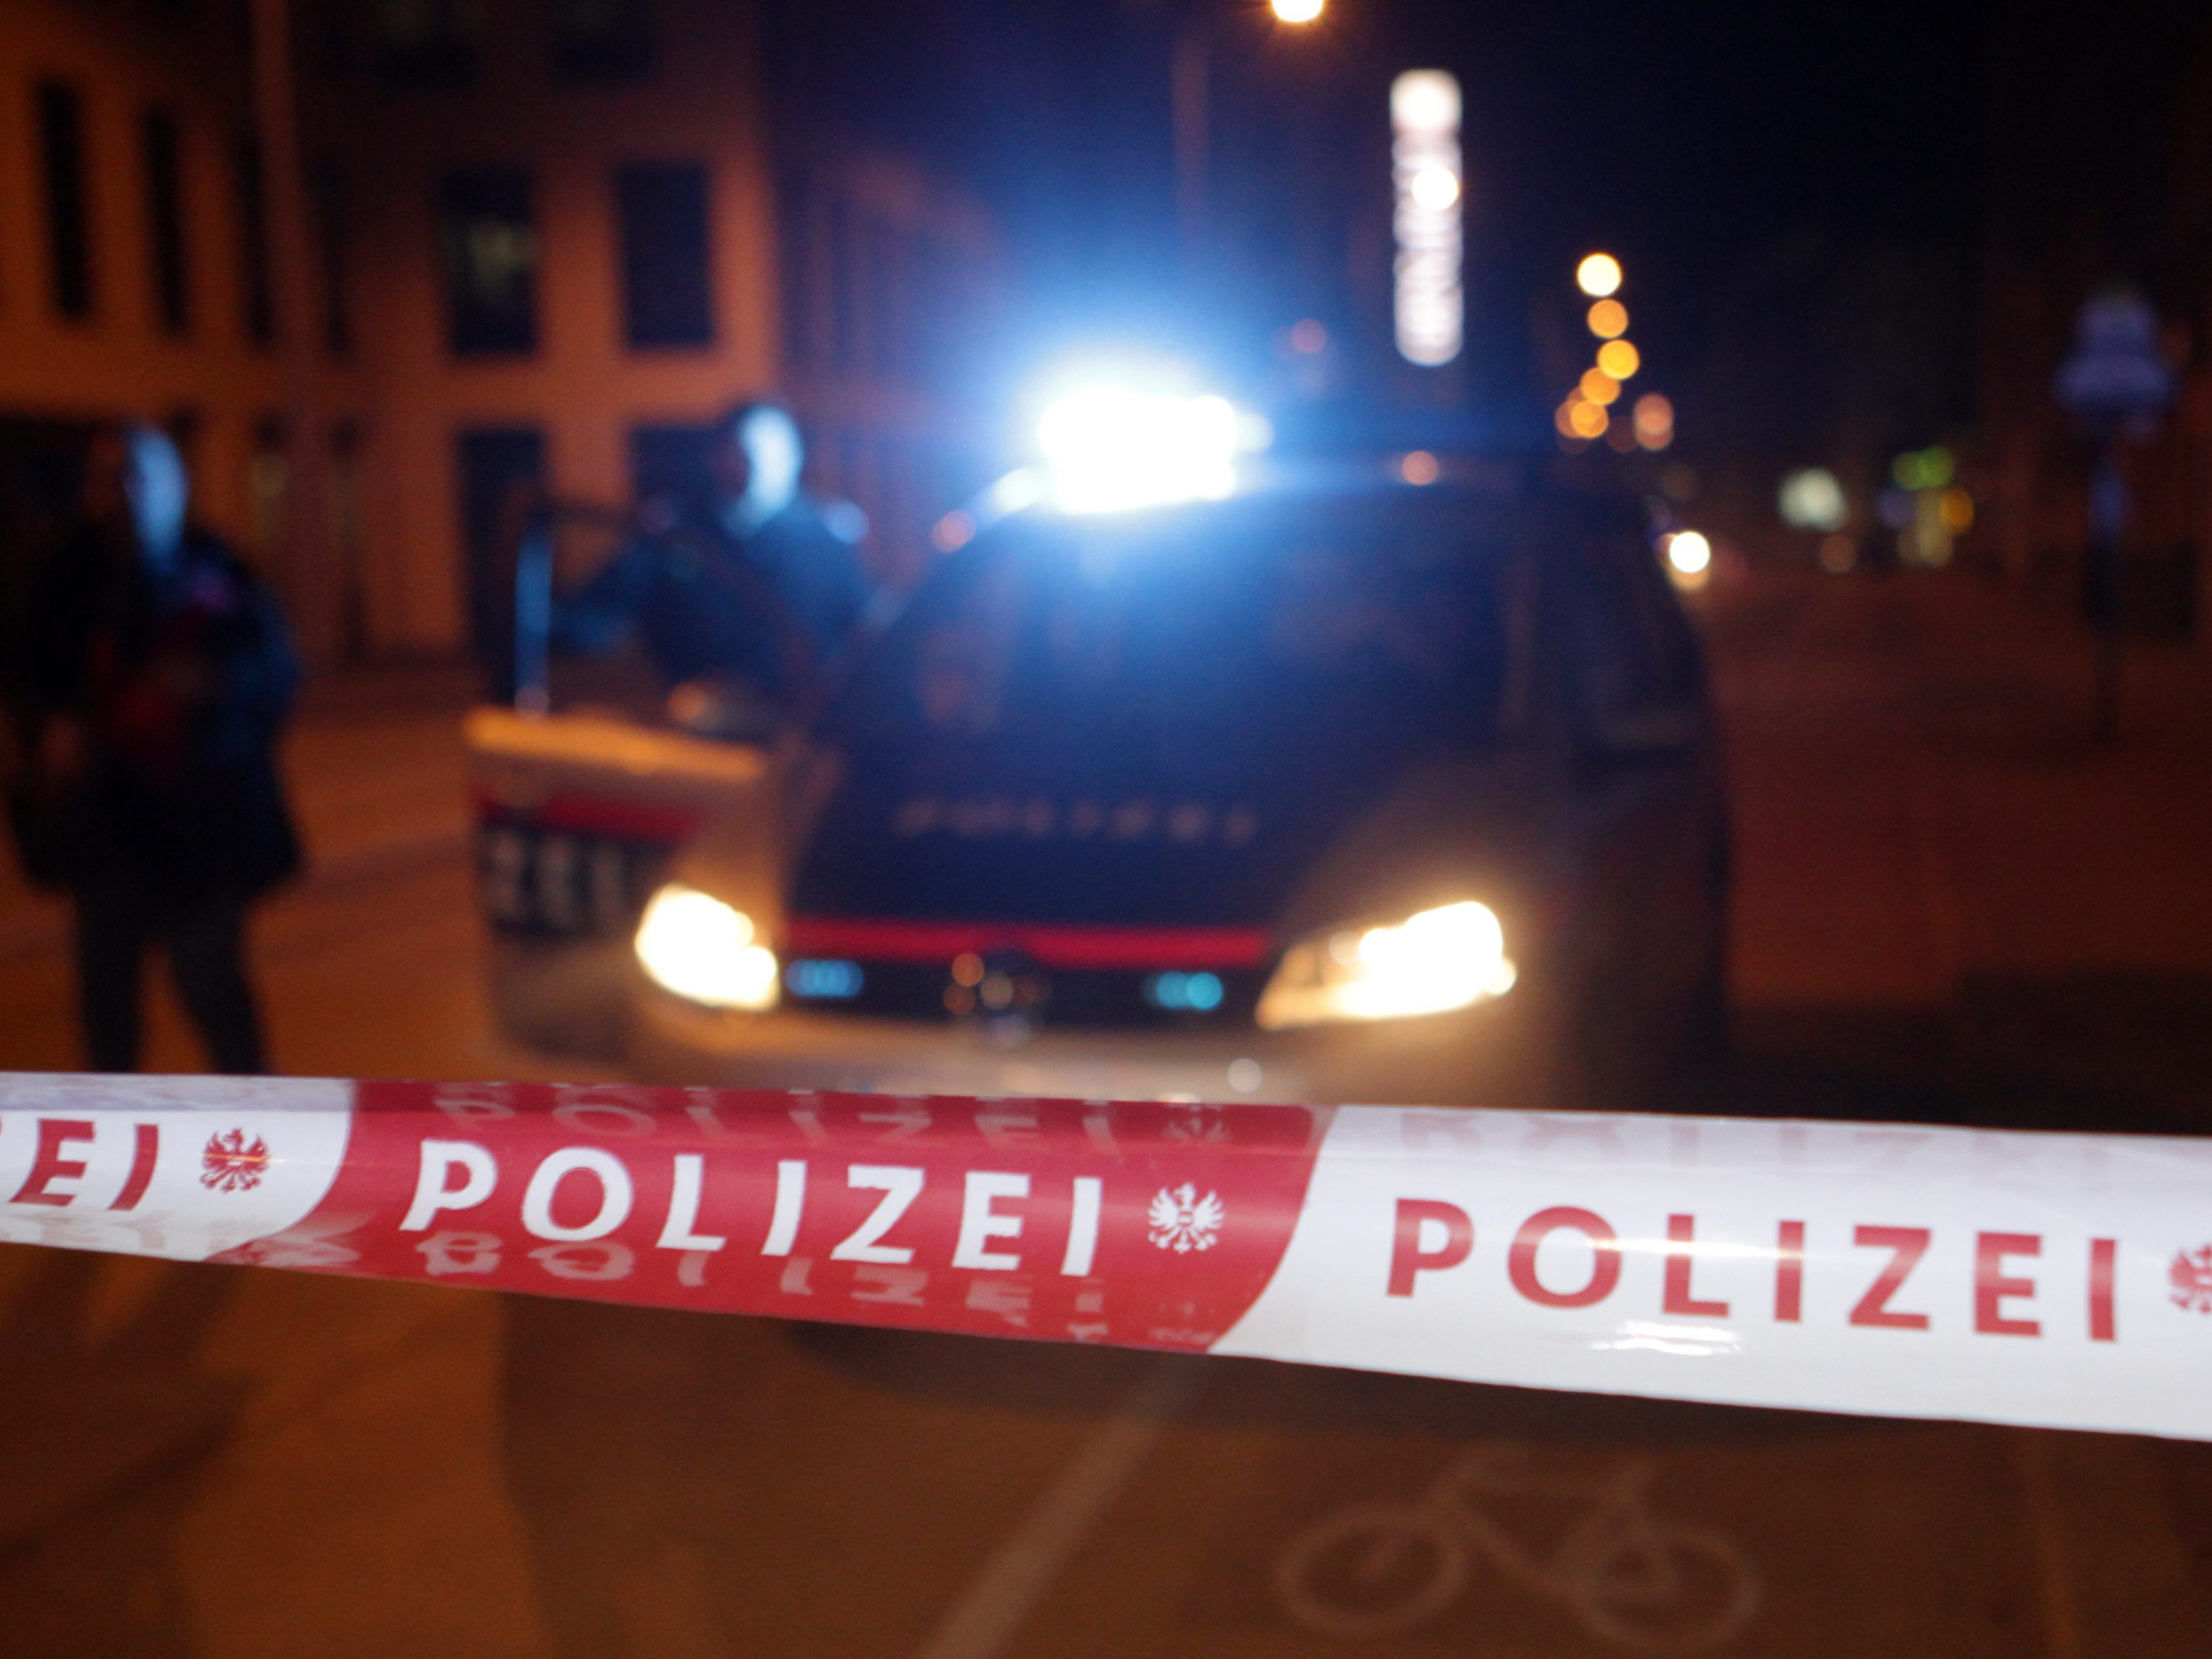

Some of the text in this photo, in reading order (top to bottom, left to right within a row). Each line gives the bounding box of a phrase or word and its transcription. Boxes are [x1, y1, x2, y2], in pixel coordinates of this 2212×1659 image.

[0, 1115, 2118, 1342] EI POLIZEI POLIZEI
